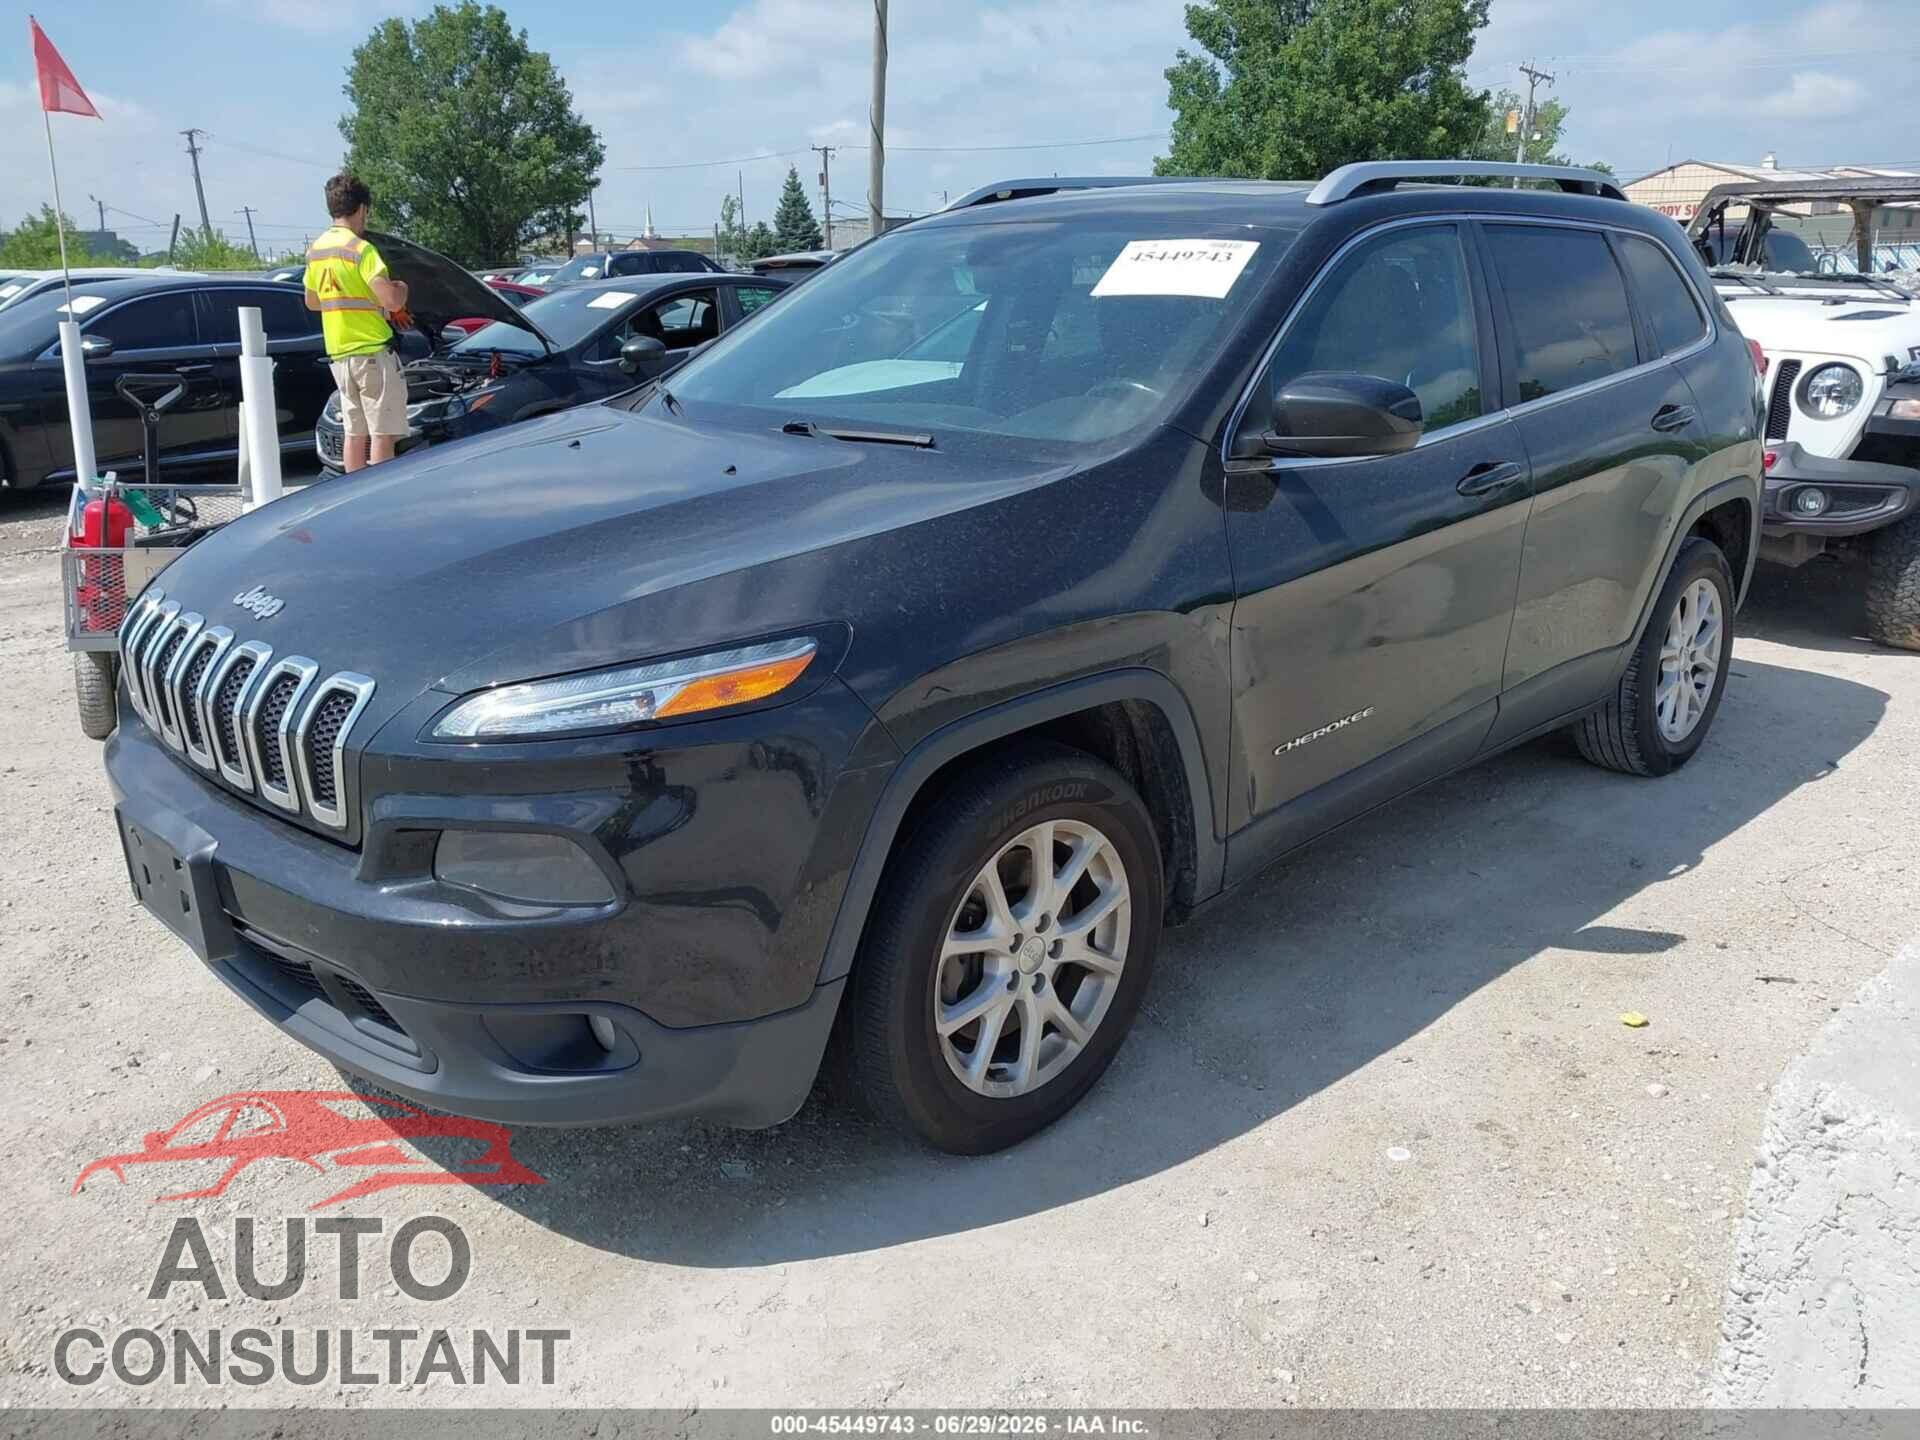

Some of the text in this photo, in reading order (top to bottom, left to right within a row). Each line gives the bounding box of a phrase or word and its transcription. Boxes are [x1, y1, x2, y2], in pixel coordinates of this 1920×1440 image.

[1129, 250, 1233, 262] 45449743
[232, 584, 285, 620] Jeep
[1273, 706, 1376, 756] CHEROKEE
